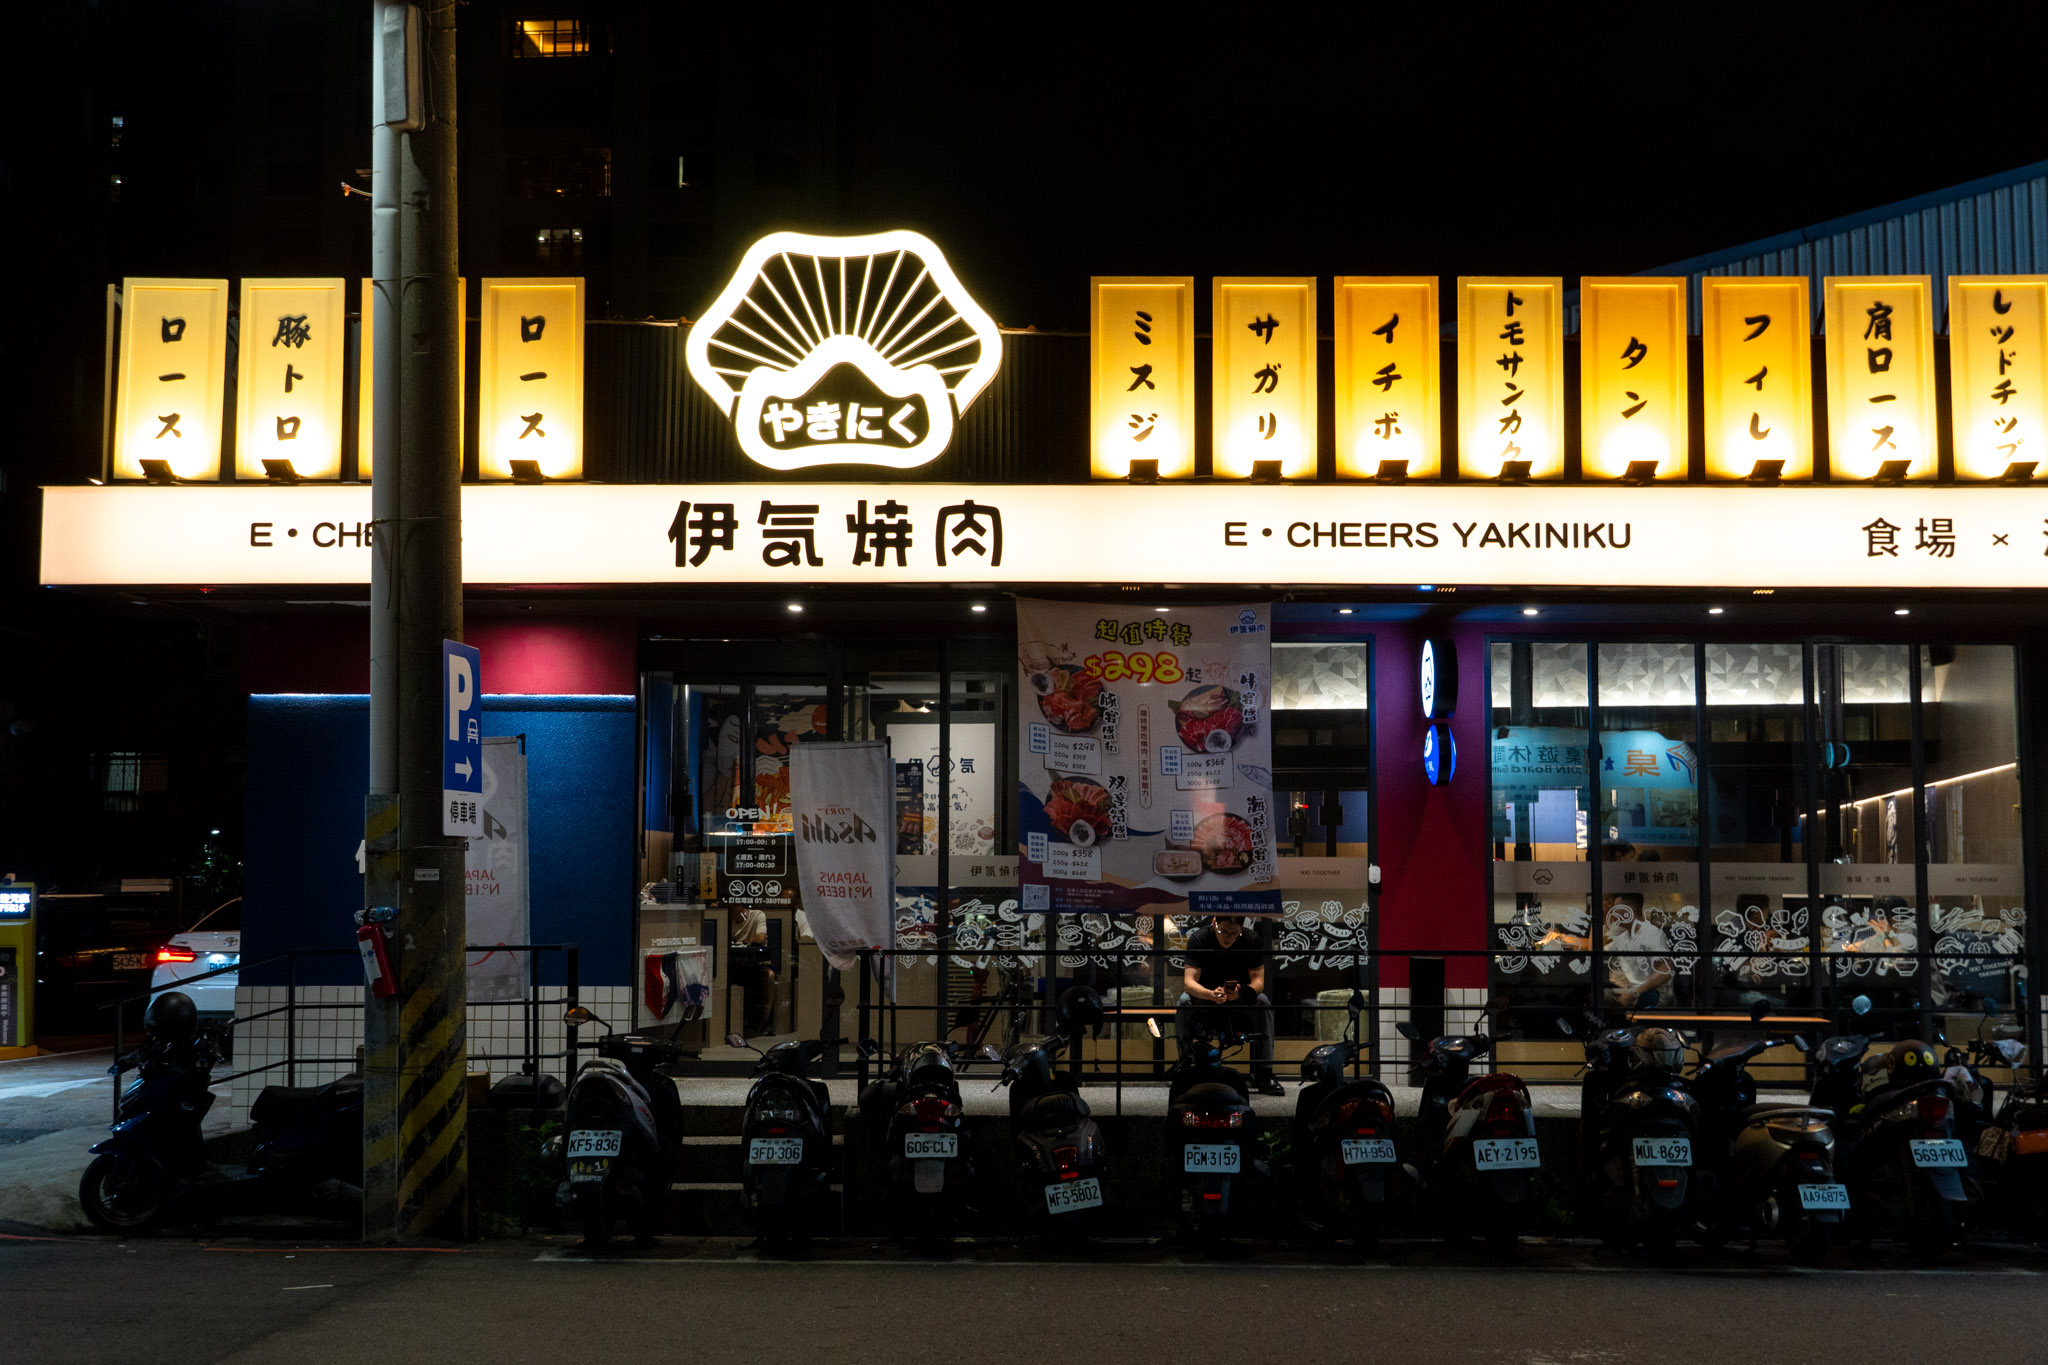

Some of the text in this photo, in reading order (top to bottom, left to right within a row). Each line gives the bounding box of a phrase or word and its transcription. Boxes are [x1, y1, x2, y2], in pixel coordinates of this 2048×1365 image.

[158, 315, 188, 440] ロース
[271, 314, 312, 441] 豚トロ
[518, 314, 548, 440] ロース
[1127, 310, 1158, 442] ミスジ
[1247, 313, 1282, 440] サガリ
[1371, 313, 1403, 440] イチボ
[1620, 336, 1649, 420] タン
[1863, 301, 1898, 453] 肩ロース
[763, 401, 917, 443] やきにく
[1286, 521, 1440, 548] CHEERS
[1452, 521, 1632, 549] YAKINIKU
[1861, 517, 1956, 558] 食場
[1095, 617, 1192, 646] 超值特餐
[1084, 650, 1202, 684] $298 起
[448, 653, 474, 742] P
[1072, 742, 1095, 751] $298
[1205, 757, 1226, 767] $368
[725, 803, 777, 820] OPEN!
[1072, 849, 1093, 858] $358
[1250, 863, 1272, 874] $398
[569, 1138, 620, 1153] KF5-836
[751, 1146, 800, 1160] 3FD-306
[907, 1141, 955, 1154] 606-CLY
[1344, 1146, 1394, 1160] H7H-950
[1478, 1146, 1537, 1163] AEY-2195
[1635, 1145, 1688, 1159] MUL-8699
[1913, 1148, 1965, 1162] 569-PKU
[1186, 1151, 1237, 1166] PGM-3159
[1048, 1185, 1100, 1207] MFS-5802
